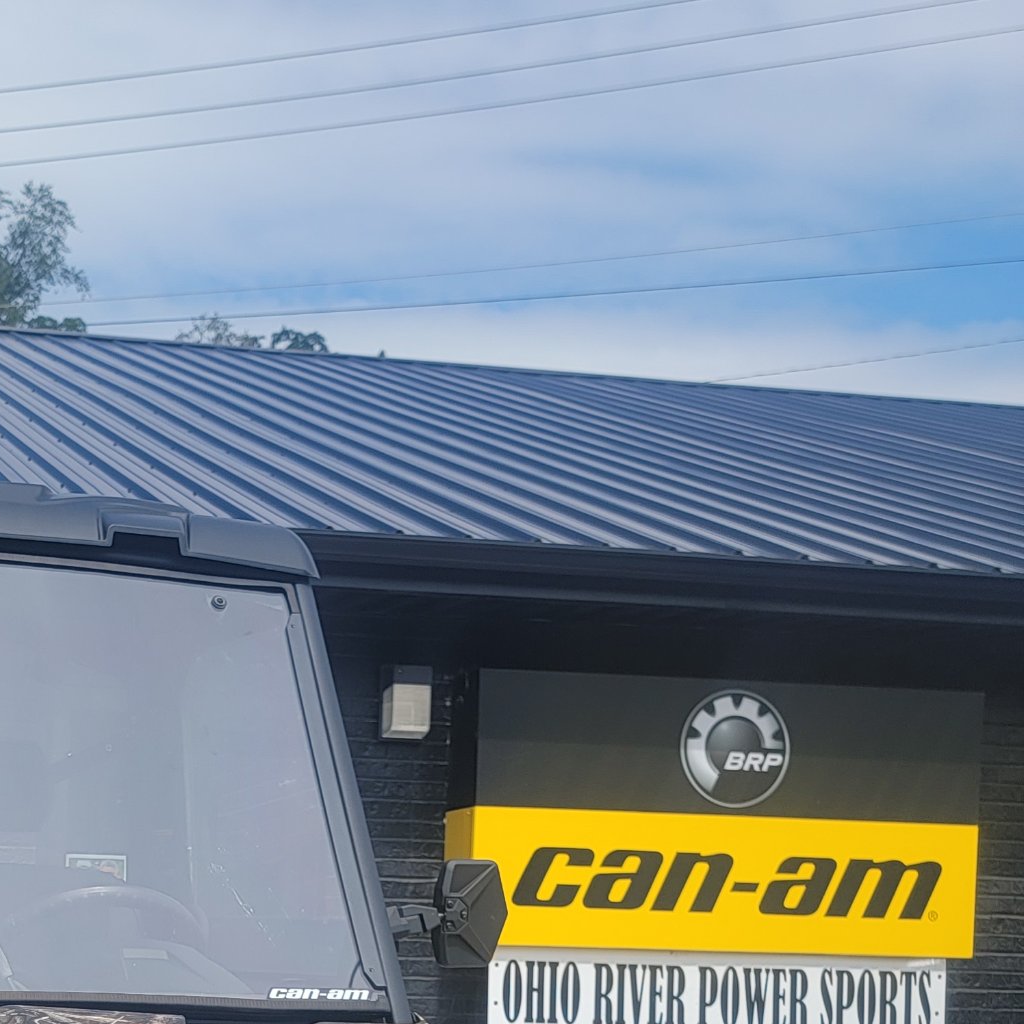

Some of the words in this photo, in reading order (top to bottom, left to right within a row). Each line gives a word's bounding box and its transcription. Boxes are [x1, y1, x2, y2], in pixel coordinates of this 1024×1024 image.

[724, 751, 783, 772] BRP
[269, 988, 369, 1000] can-am
[502, 959, 581, 1024] OHIO
